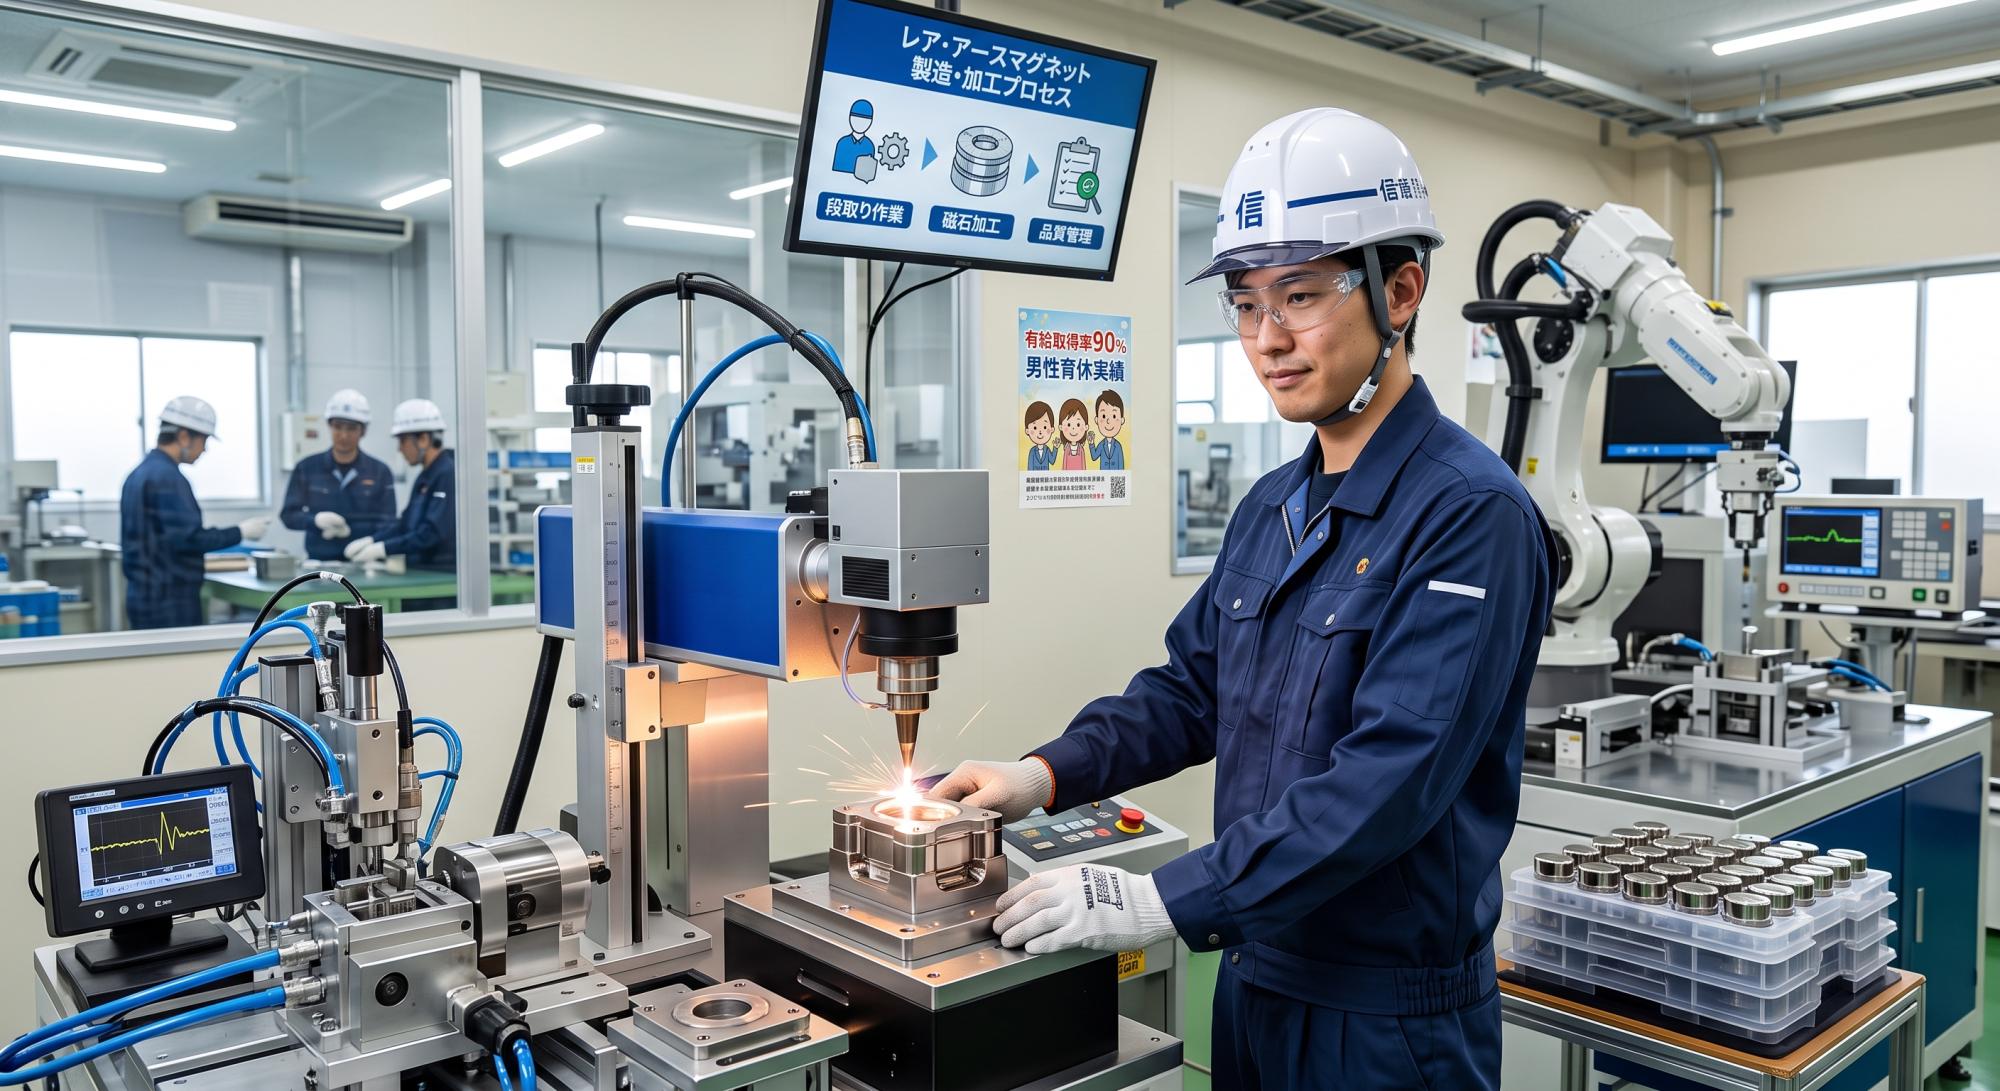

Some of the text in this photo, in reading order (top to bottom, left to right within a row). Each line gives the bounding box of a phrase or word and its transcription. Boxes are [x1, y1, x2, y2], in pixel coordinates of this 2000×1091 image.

[901, 25, 1091, 85] レア・アースマグネット
[911, 55, 1072, 109] 製造・加工プロセス
[825, 197, 905, 224] 段取り作業
[942, 210, 1001, 235] 磁石加工
[1235, 190, 1265, 230] 信
[1038, 223, 1093, 245] 品質管理
[1025, 329, 1127, 354] 有給取得率90%
[1026, 355, 1125, 382] 男性育休実績
